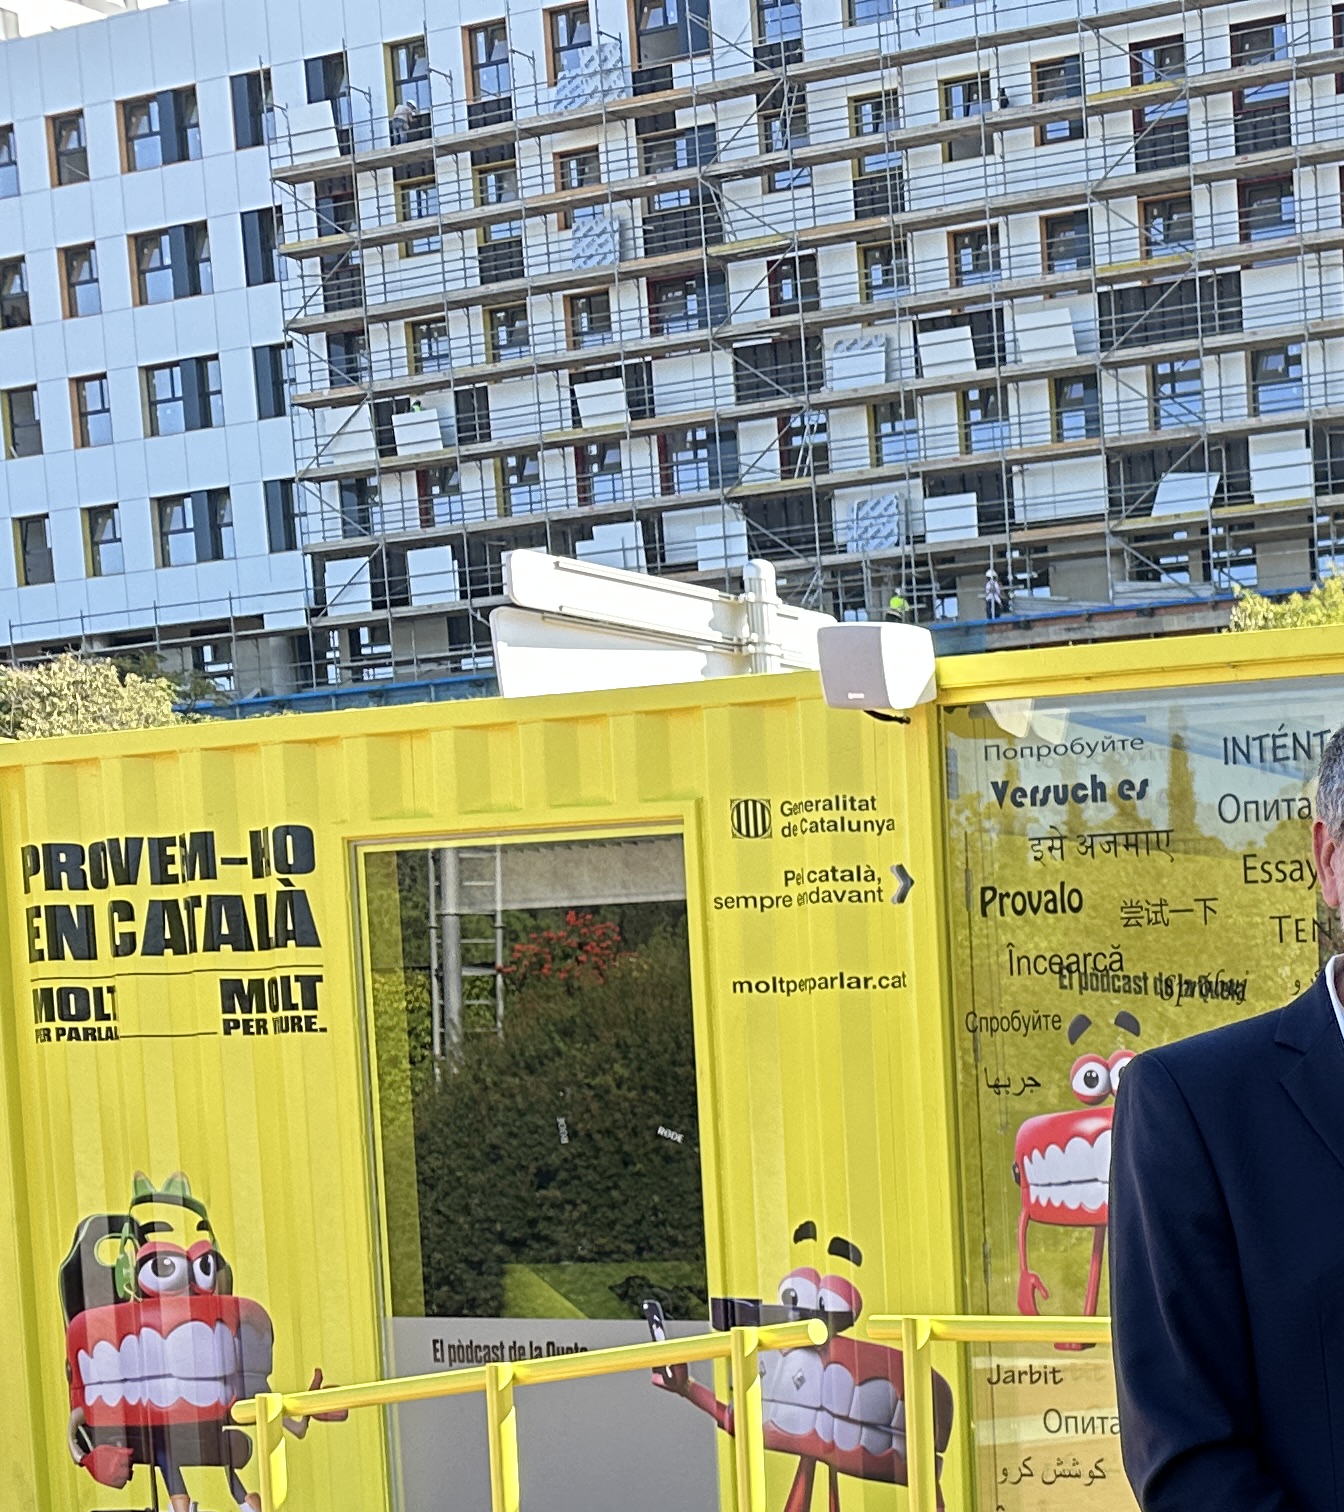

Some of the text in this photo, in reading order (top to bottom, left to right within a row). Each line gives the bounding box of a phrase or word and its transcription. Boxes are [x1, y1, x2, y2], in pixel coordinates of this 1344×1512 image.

[984, 735, 1144, 762] Попробуйте
[990, 774, 1149, 809] Versuch es
[781, 795, 876, 817] Generalitat
[781, 816, 895, 838] de Catalunya
[21, 824, 316, 894] PROVEM-HO
[784, 865, 882, 887] Pel català,
[714, 886, 884, 912] sempre endavant
[980, 881, 1083, 918] Provalo
[26, 877, 322, 963] EN CATALÀ
[1120, 898, 1218, 929] 尝试一下
[219, 975, 323, 1014] MOLT
[732, 971, 907, 997] moltperparlar.cat
[223, 1017, 268, 1036] PER
[965, 1009, 1062, 1037] Спробуйте
[432, 1339, 444, 1363] El
[448, 1339, 504, 1367] pòdcast
[987, 1363, 1064, 1387] Jarbit
